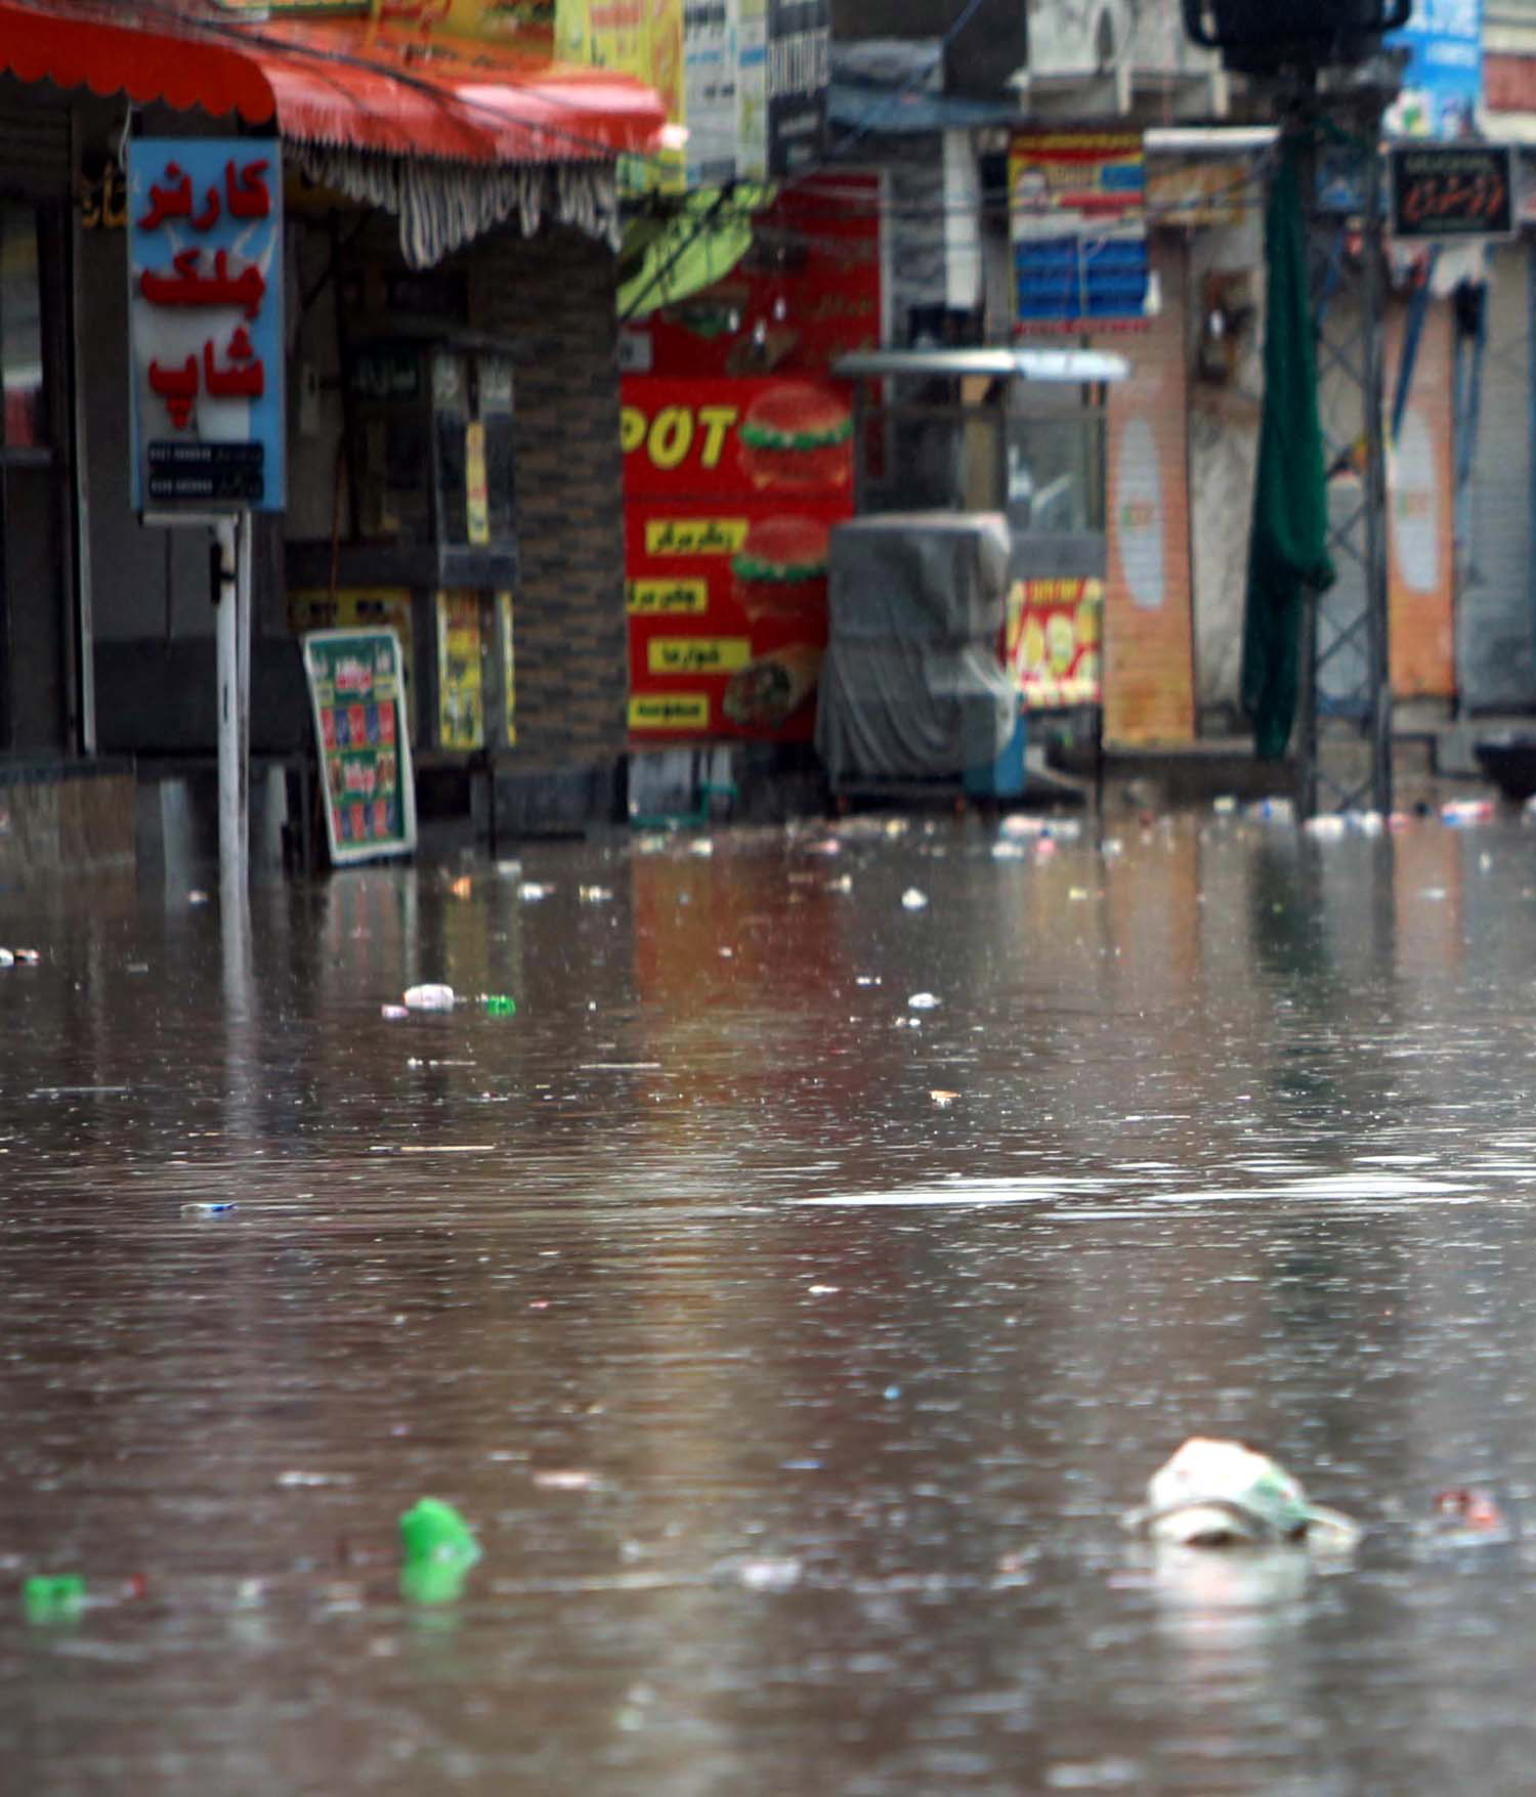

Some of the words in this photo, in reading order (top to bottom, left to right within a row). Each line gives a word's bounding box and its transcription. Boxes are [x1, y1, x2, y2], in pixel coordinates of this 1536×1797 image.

[138, 158, 270, 230] کارنر
[139, 247, 267, 322] ملک
[147, 325, 265, 432] شاپ
